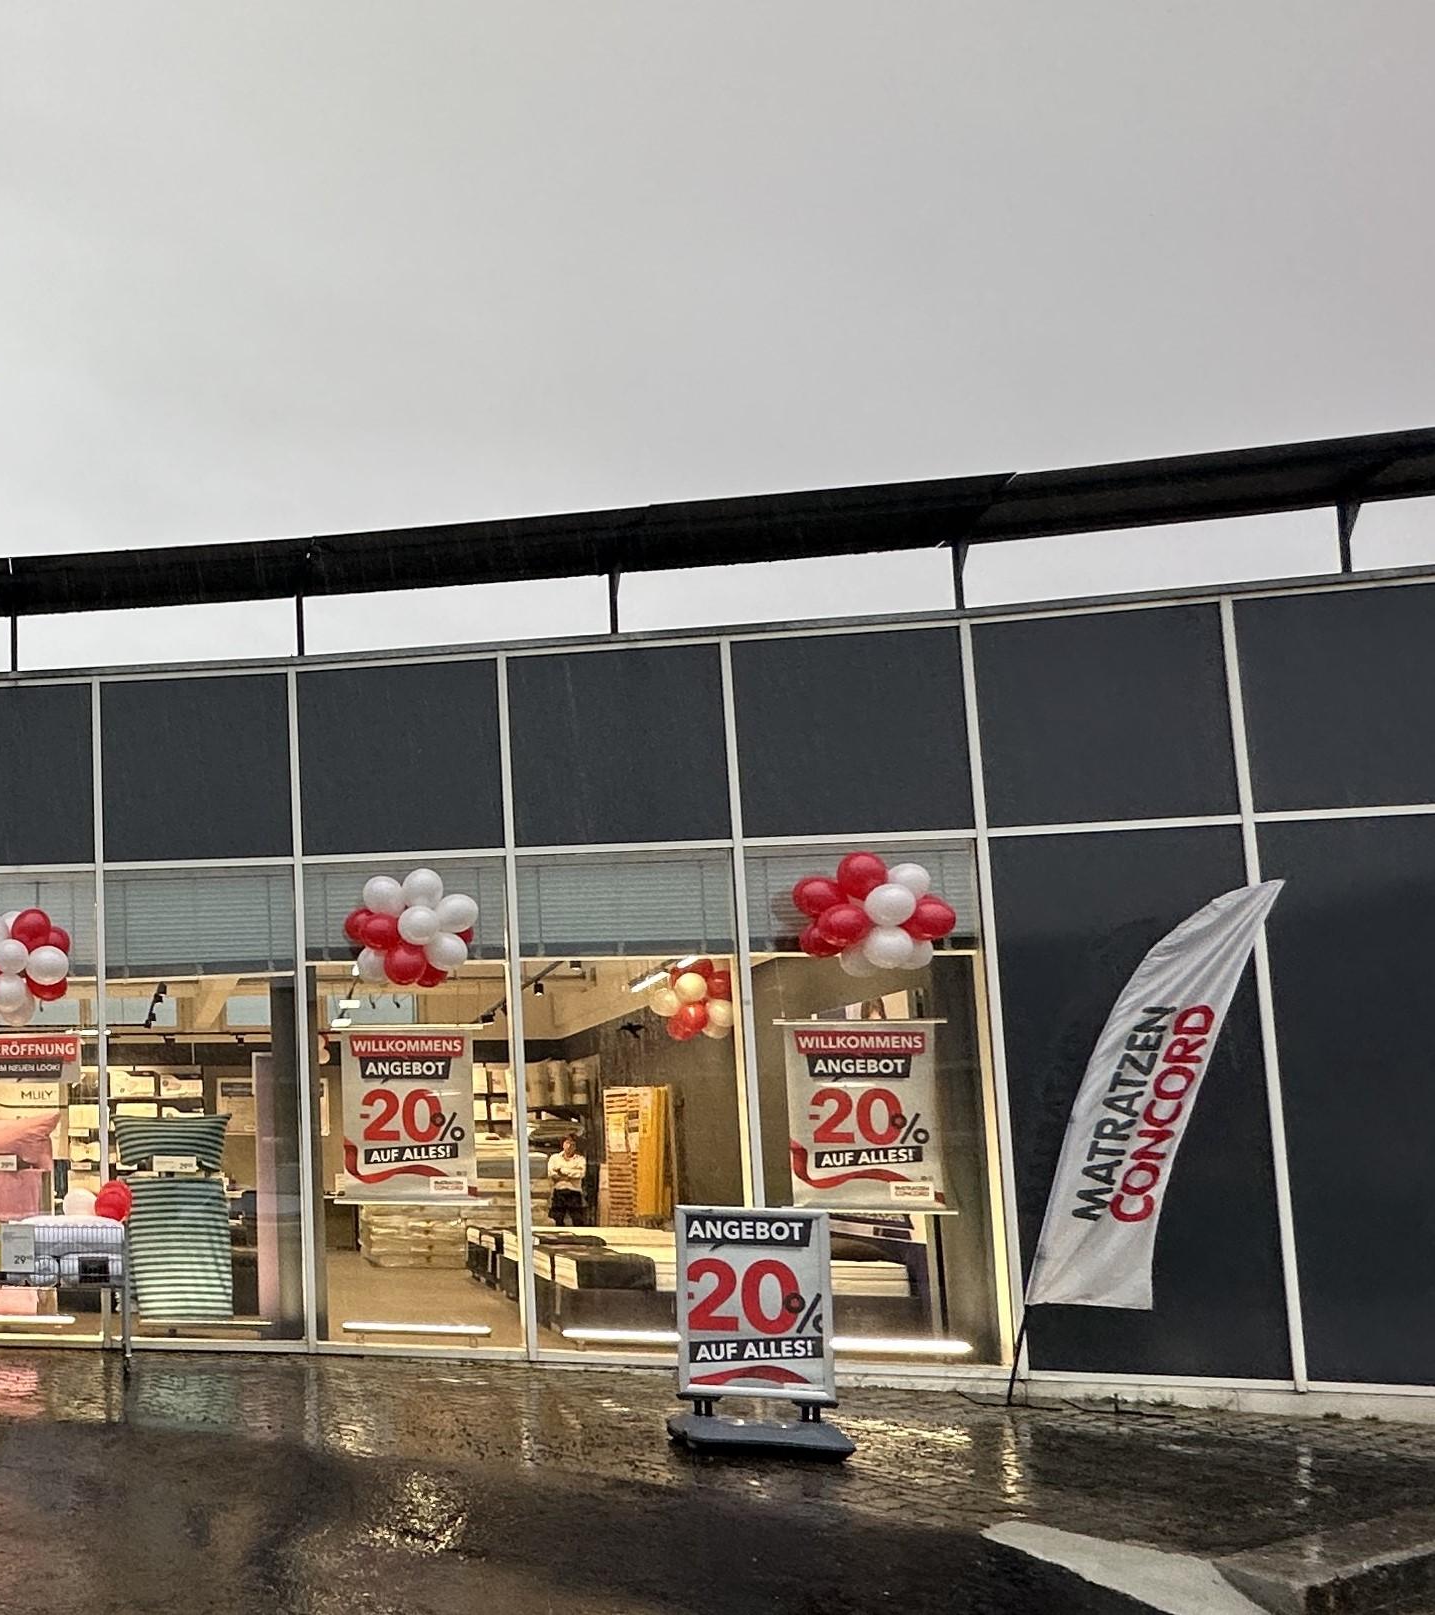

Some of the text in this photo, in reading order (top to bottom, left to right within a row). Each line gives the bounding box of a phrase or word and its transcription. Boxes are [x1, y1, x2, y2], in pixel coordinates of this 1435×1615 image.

[352, 1039, 462, 1052] WILLKOMMENS
[798, 1035, 923, 1049] WILLKOMMENS
[8, 1064, 35, 1072] NEUEN
[365, 1061, 446, 1076] ANGEBOT
[814, 1059, 905, 1074] ANGEBOT
[1071, 1004, 1177, 1222] MATRATZEN
[1109, 1003, 1215, 1223] CONCORD
[370, 1145, 451, 1163] AUF ALLES!
[820, 1148, 914, 1167] AUF ALLES!
[688, 1220, 804, 1241] ANGEBOT
[695, 1339, 814, 1361] AUF ALLES!
